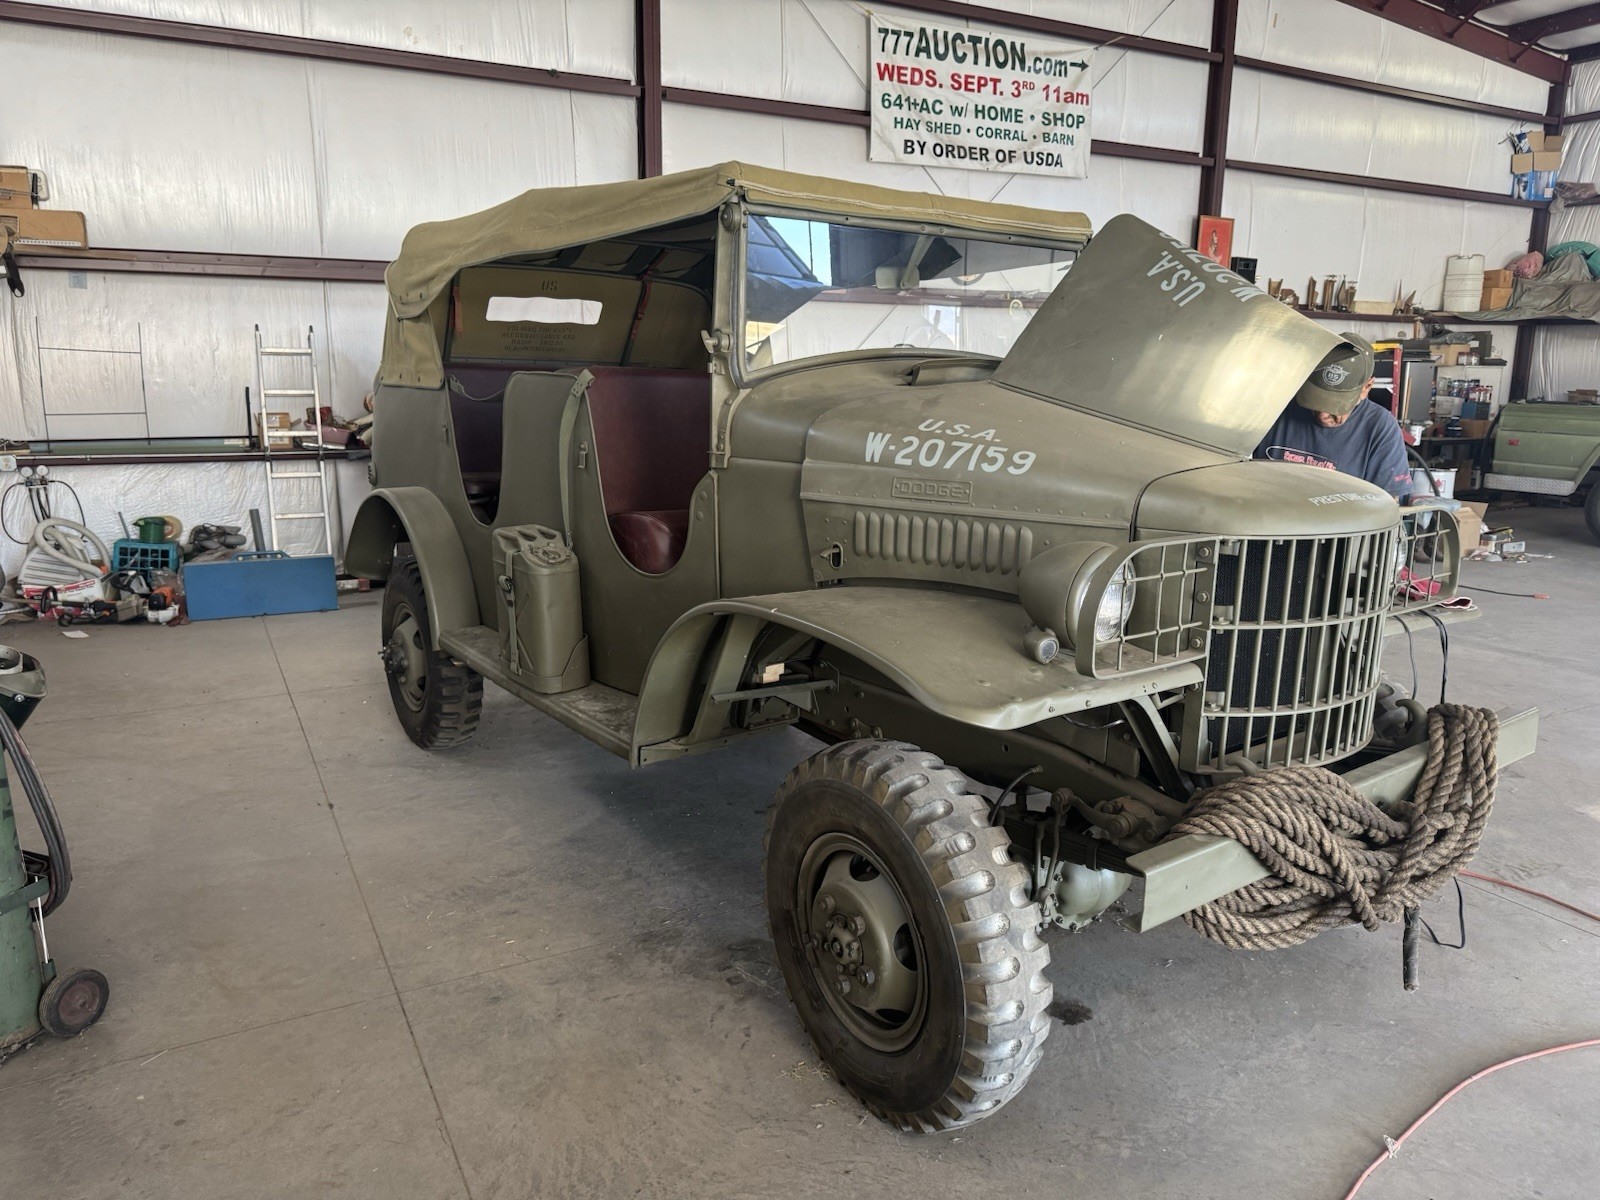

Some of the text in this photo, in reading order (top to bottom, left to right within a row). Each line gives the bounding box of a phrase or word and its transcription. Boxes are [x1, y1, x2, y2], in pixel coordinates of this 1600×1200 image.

[878, 27, 1068, 78] 777AUCTION.com
[877, 62, 1090, 106] WEDS. SEPT. 3RD 11am
[881, 92, 1085, 130] 641+AC w/ HOME SHOP
[894, 117, 1074, 146] HAY SHED CORRAL BARN
[903, 139, 1064, 168] BY ORDER OF USDA
[918, 418, 1003, 442] U.S.A.
[865, 431, 1037, 475] W-207159
[901, 480, 964, 498] DODGE
